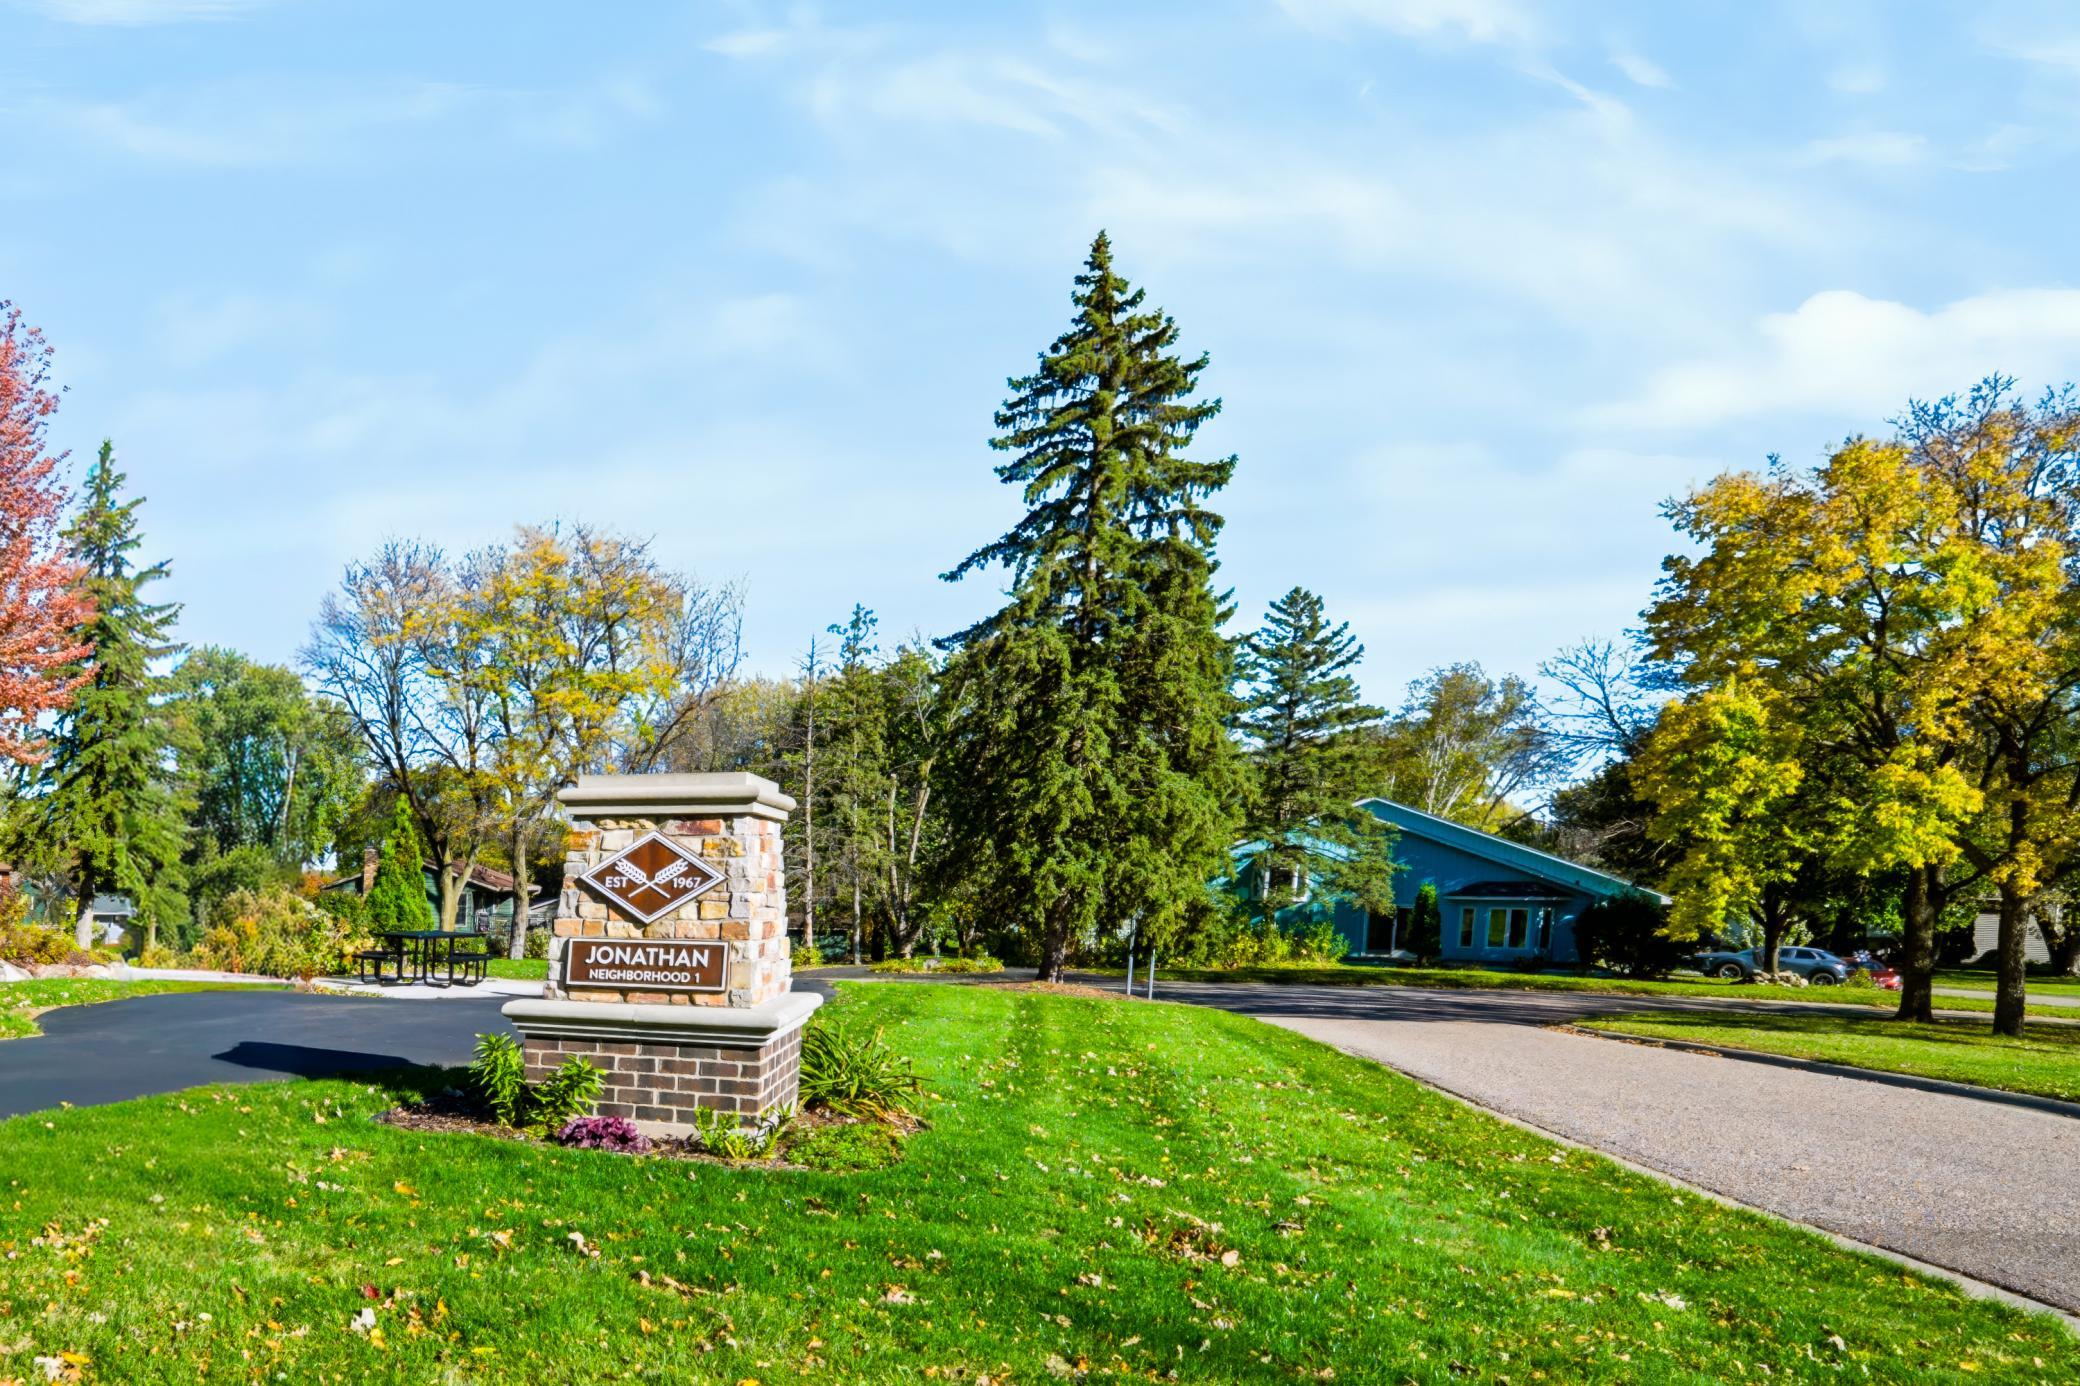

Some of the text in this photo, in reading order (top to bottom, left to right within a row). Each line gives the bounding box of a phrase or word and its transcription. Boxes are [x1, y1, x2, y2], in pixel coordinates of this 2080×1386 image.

[605, 877, 702, 888] EST 1967
[585, 946, 709, 968] JONATHAN
[589, 969, 700, 983] NEIGHBORHOOD 1
